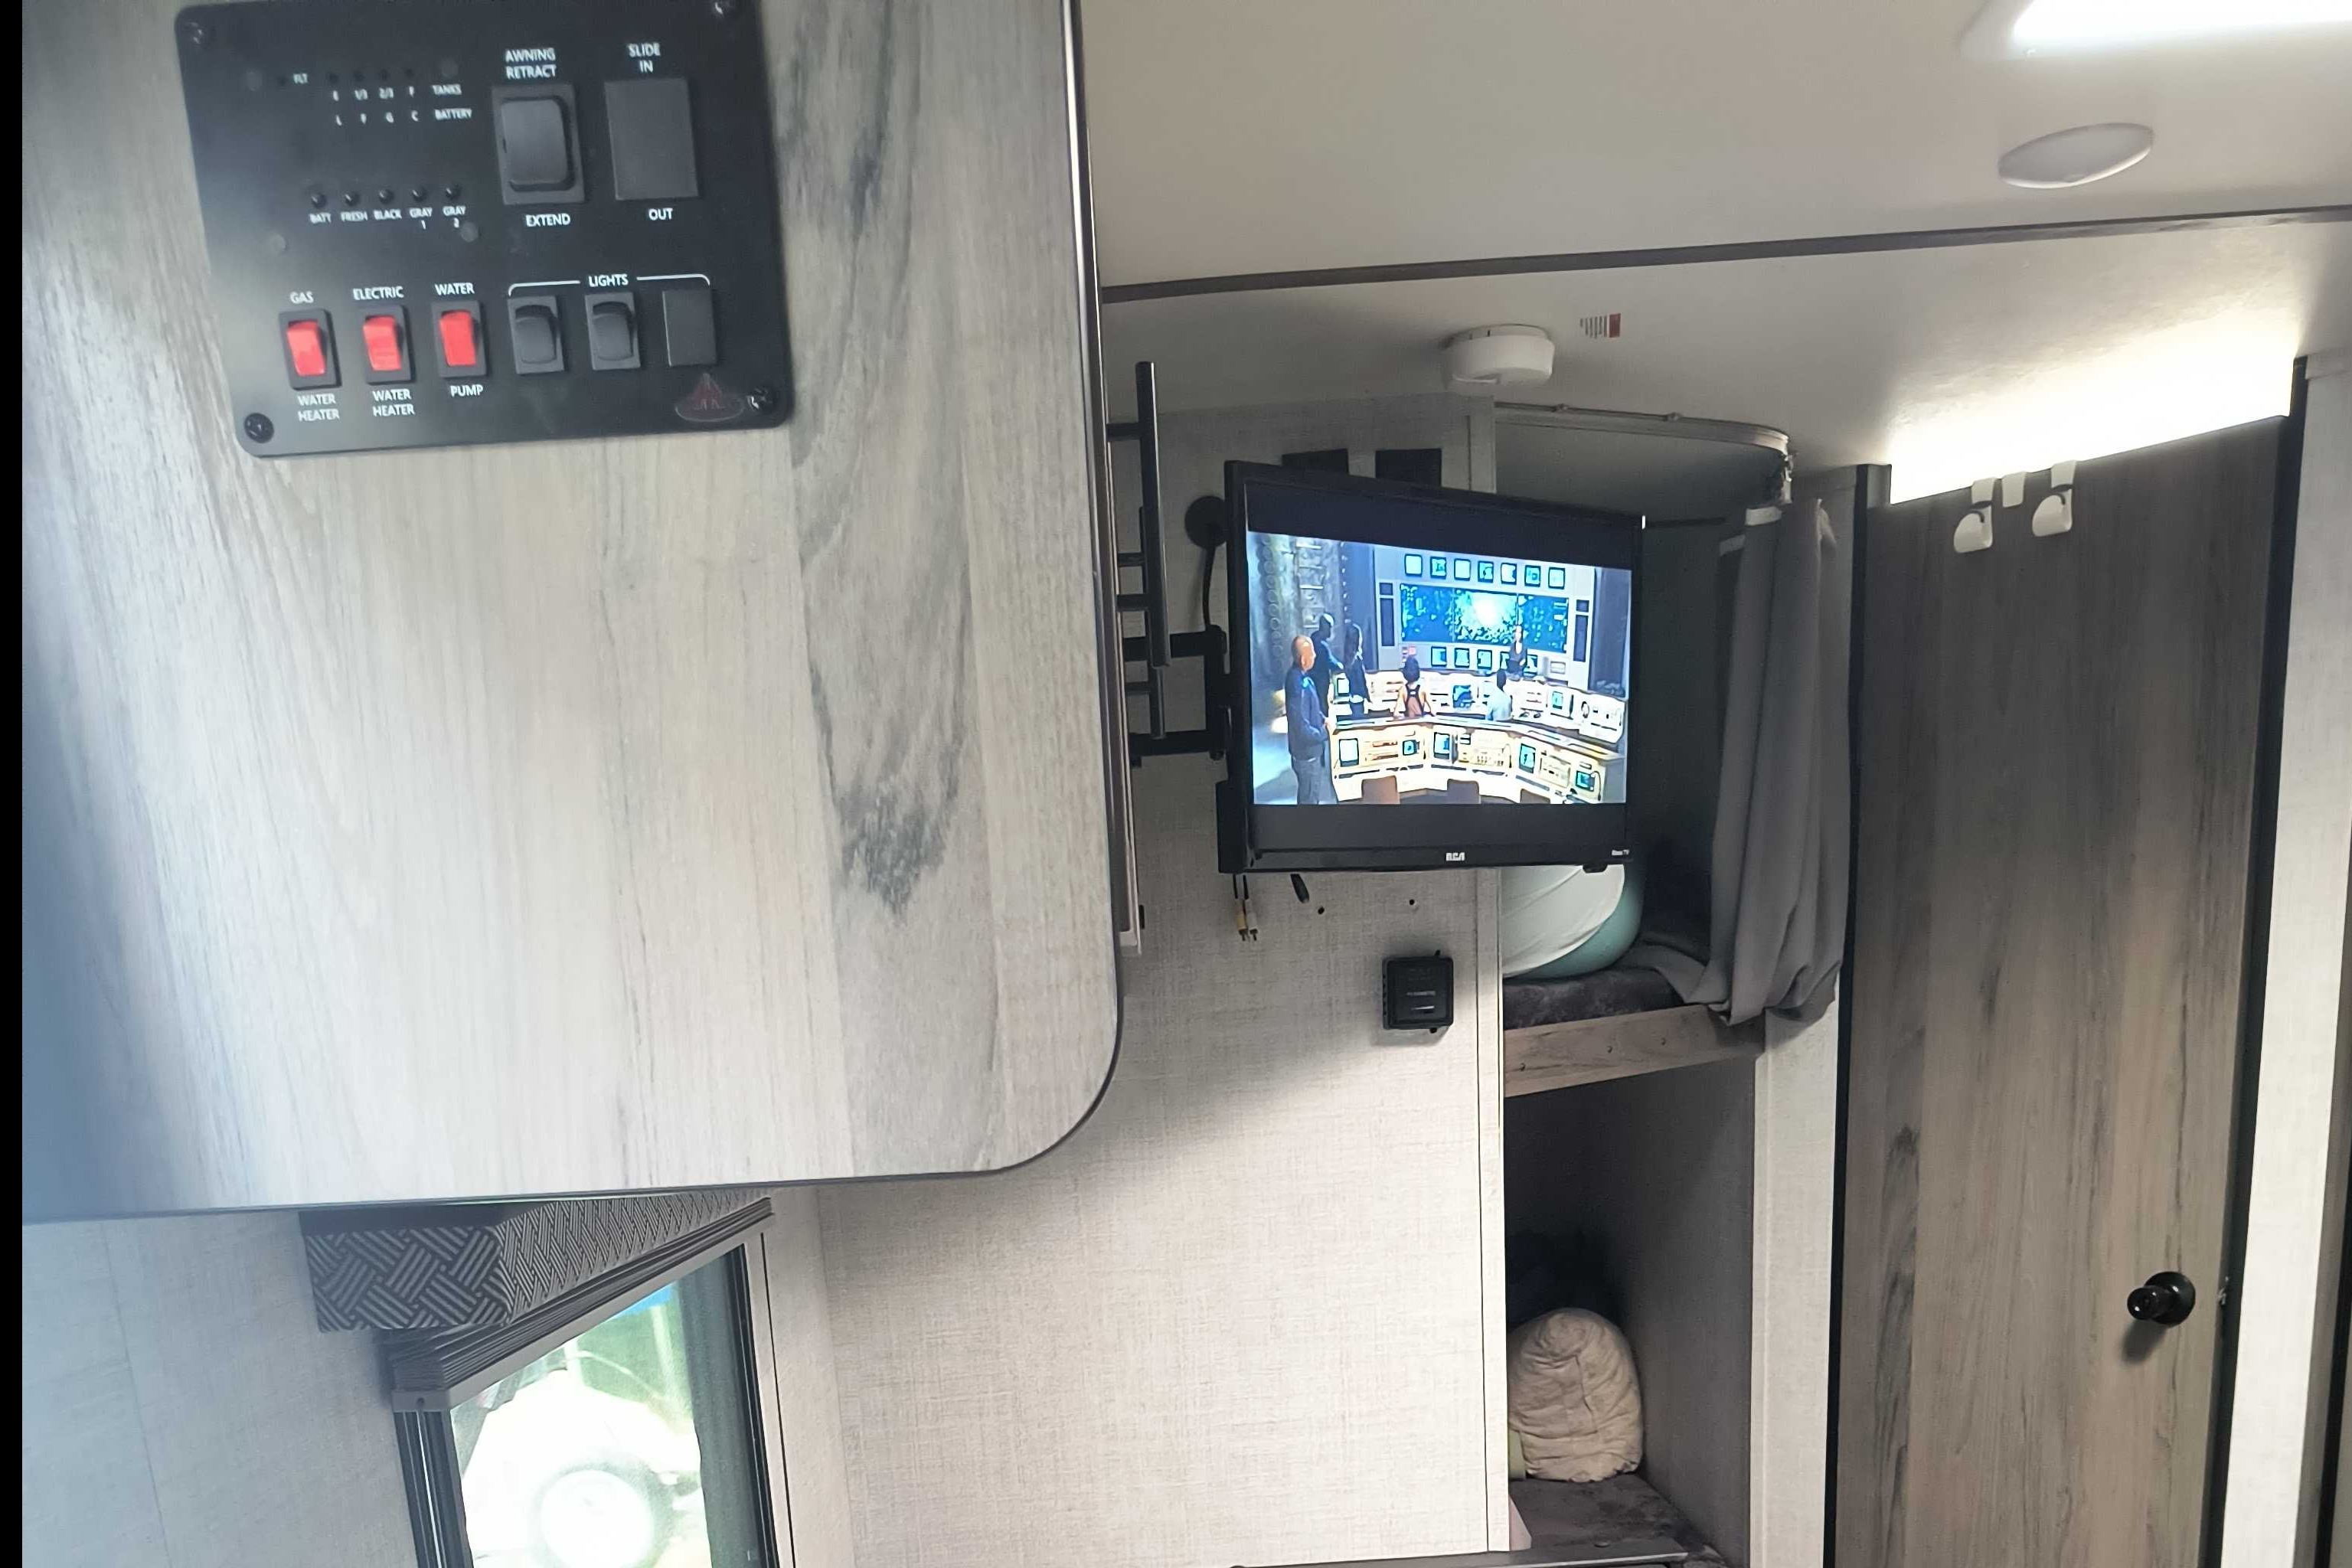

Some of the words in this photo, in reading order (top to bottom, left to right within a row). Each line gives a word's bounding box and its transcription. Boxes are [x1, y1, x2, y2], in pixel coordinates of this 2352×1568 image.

[505, 47, 556, 62] AWNING
[627, 43, 661, 57] SLIDE
[506, 64, 557, 80] RETRACT
[639, 60, 653, 74] IN
[432, 83, 462, 95] TANKS
[434, 108, 472, 120] BATTERY
[309, 212, 332, 224] BATT
[341, 211, 368, 222] FRESH
[373, 209, 402, 220] BLACK
[409, 207, 433, 218] GRAY
[443, 205, 466, 217] GRAY
[526, 213, 571, 227] EXTEND
[648, 207, 673, 220] OUT
[421, 220, 426, 230] 1
[588, 273, 629, 287] LIGHTS
[289, 291, 315, 304] GAS
[353, 286, 404, 301] ELECTRIC
[435, 282, 475, 296] WATER
[297, 393, 336, 407] WATER
[372, 388, 411, 402] WATER
[450, 384, 484, 397] PUMP
[298, 408, 340, 422] HEATER
[372, 403, 415, 417] HEATER
[1446, 852, 1465, 861] RCA
